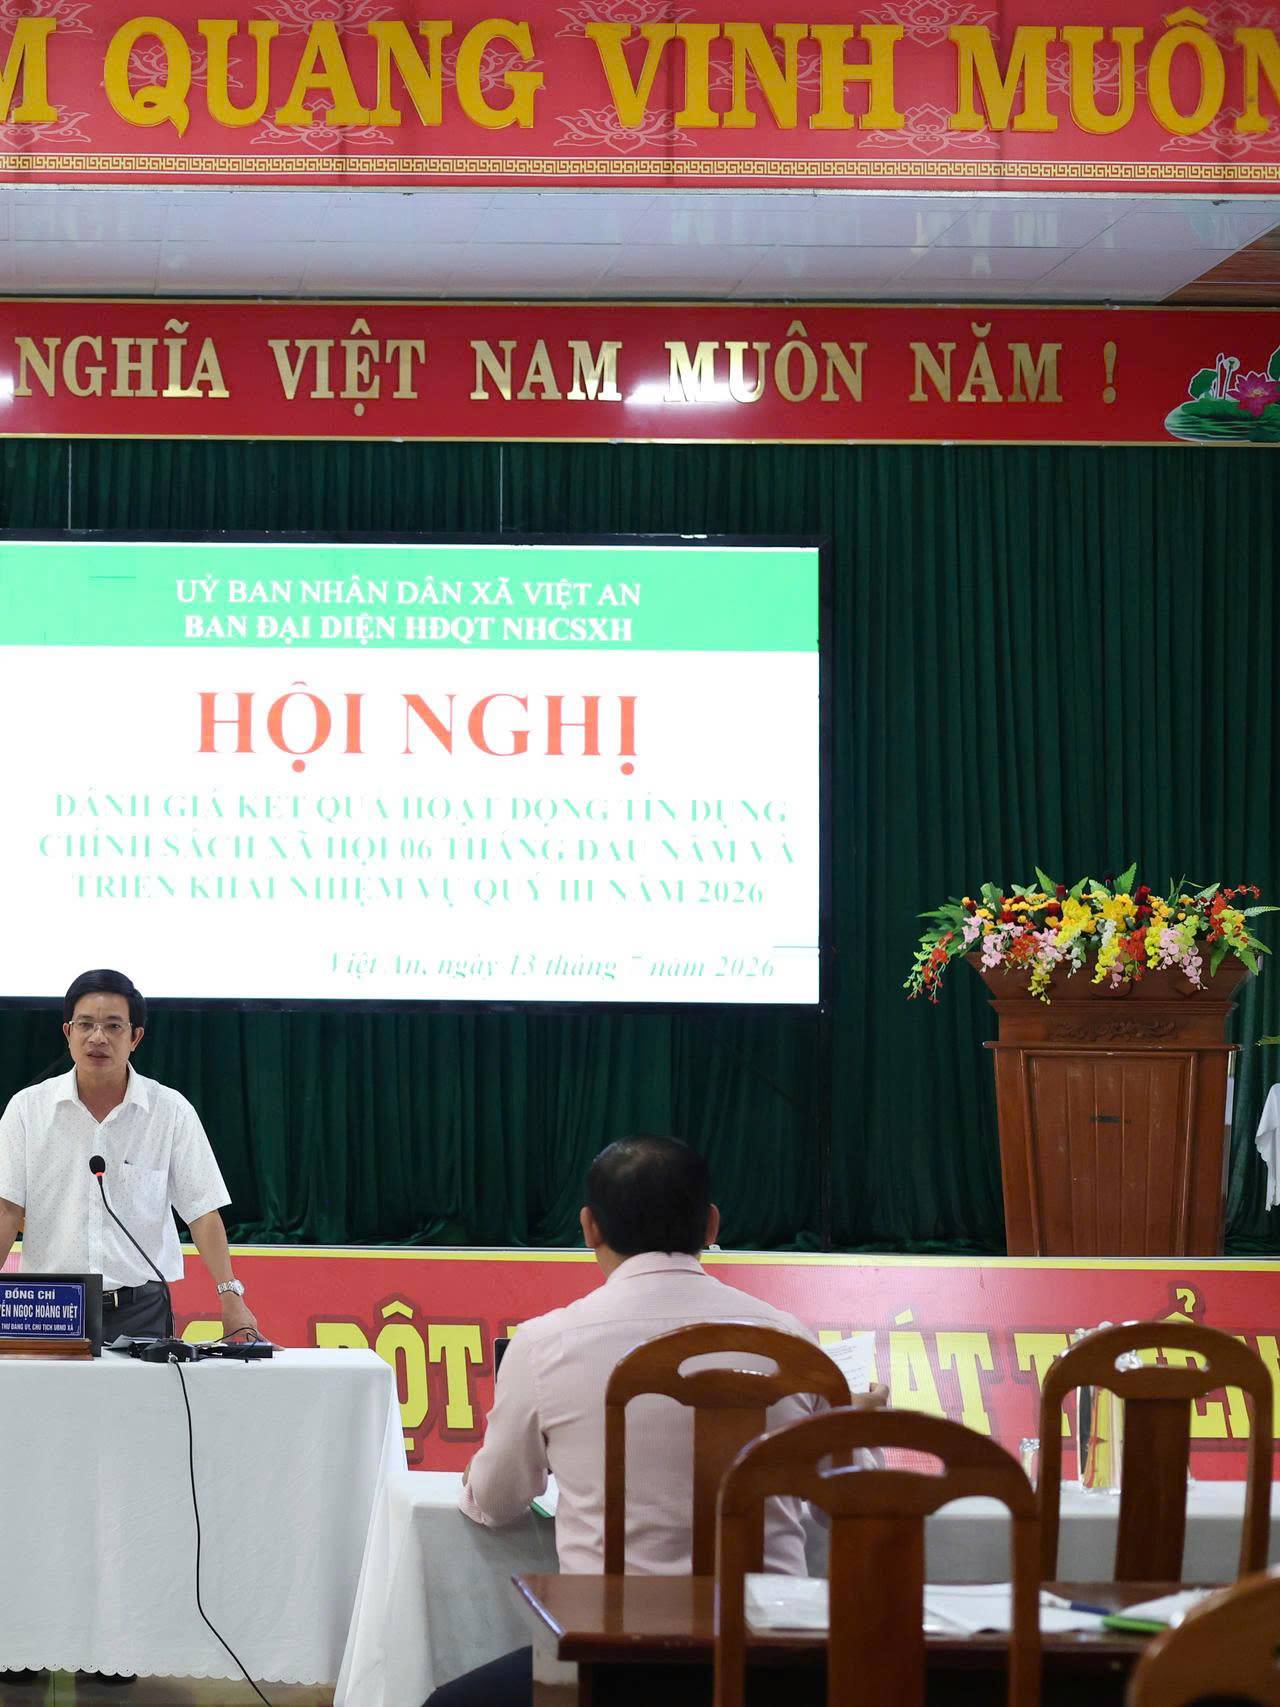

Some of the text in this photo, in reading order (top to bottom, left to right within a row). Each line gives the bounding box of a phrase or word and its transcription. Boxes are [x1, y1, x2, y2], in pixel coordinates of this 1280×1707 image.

[104, 17, 544, 138] QUANG
[585, 21, 905, 131] VINH
[14, 320, 230, 400] NGHĨA
[267, 318, 426, 417] VIỆT
[470, 340, 624, 402] NAM
[662, 320, 868, 404] MUÔN
[909, 322, 1063, 403] NĂM
[1102, 341, 1118, 401] !
[228, 579, 292, 604] BAN
[300, 574, 388, 605] NHÂN
[396, 575, 463, 605] DÂN
[471, 576, 515, 606] XÃ
[523, 577, 593, 610] VIỆT
[597, 583, 641, 608] AN
[184, 612, 633, 646] BAN ĐẠI DIỆN HĐQT NHCSXH
[196, 681, 638, 776] HỘI NGHỊ
[699, 880, 764, 905] 2026
[13, 1304, 34, 1320] NGỌC
[35, 1303, 61, 1319] HOÀNG
[62, 1303, 78, 1321] VIỆT
[316, 1300, 484, 1451] ỘT
